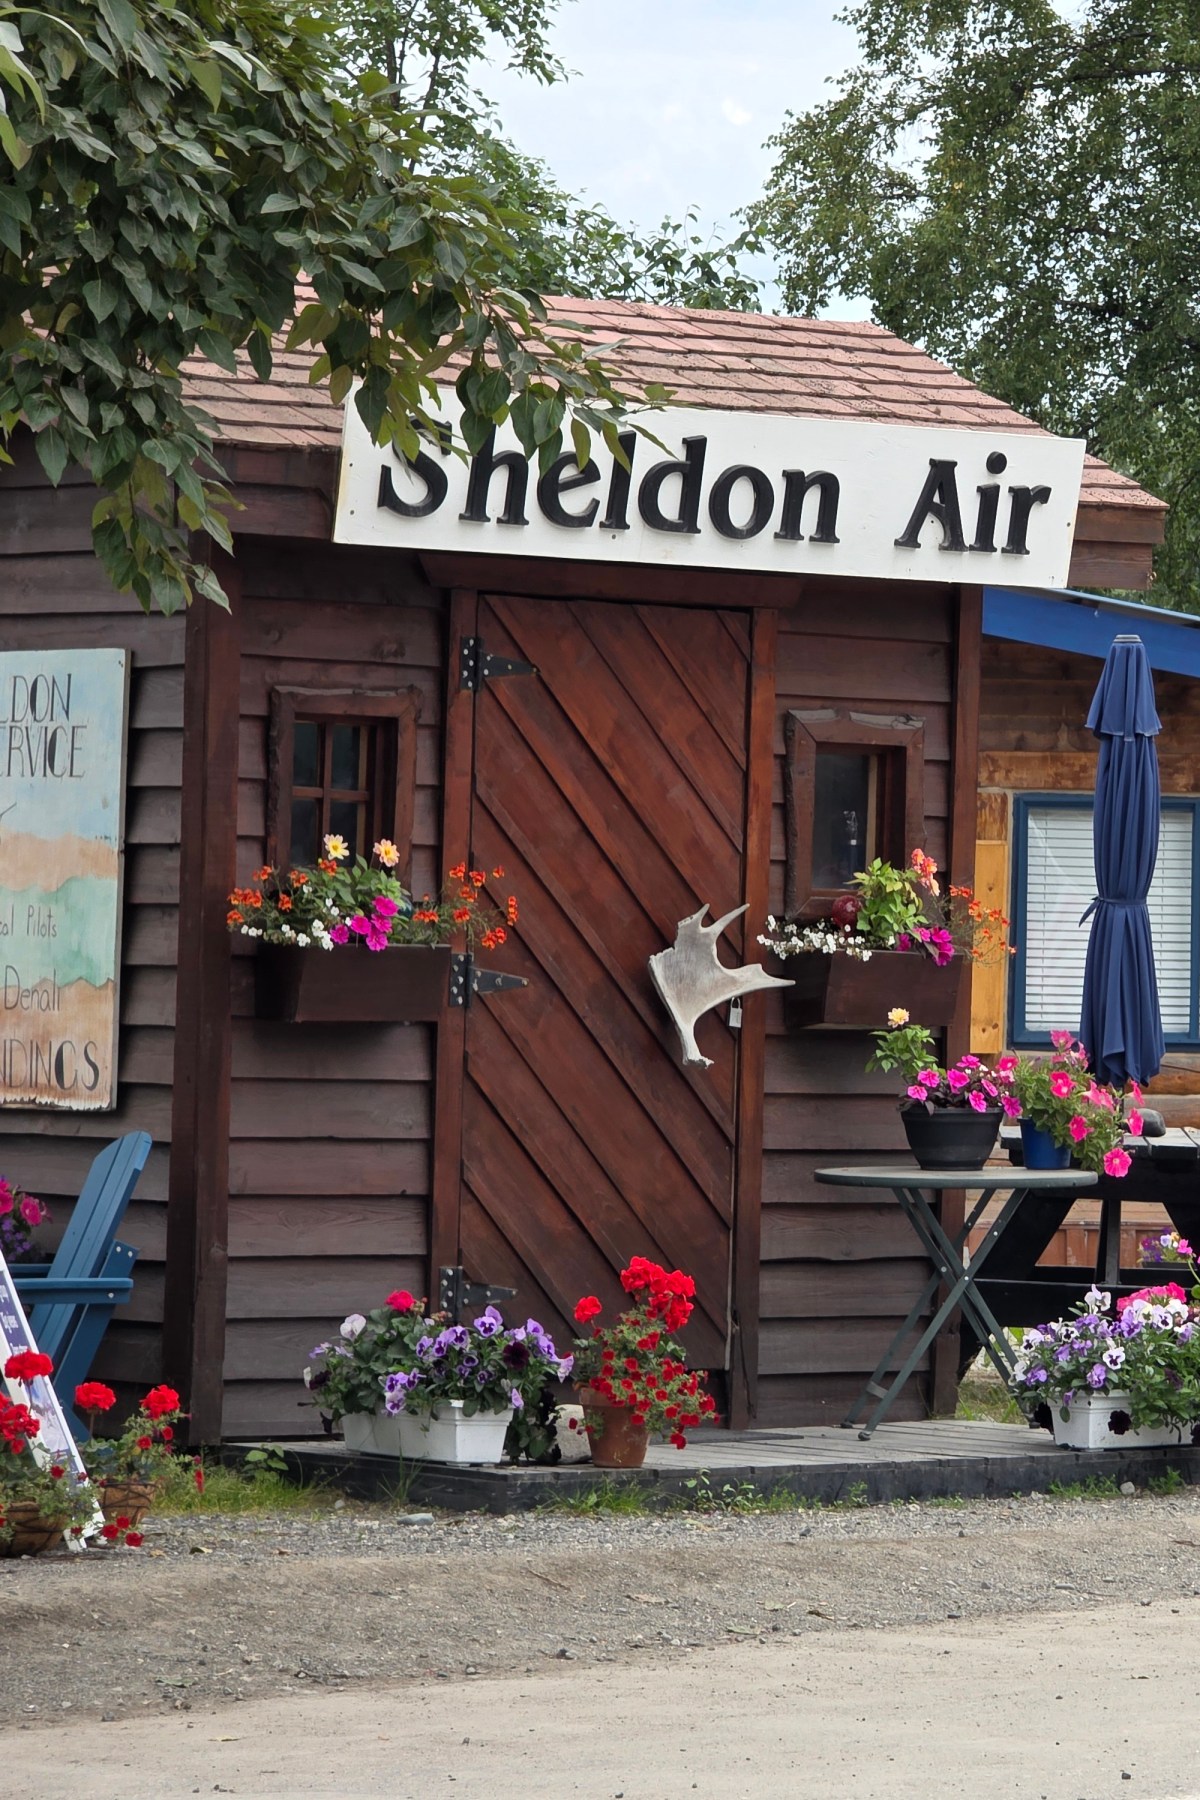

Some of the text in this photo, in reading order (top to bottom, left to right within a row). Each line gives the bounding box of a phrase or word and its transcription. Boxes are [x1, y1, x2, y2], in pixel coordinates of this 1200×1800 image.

[377, 415, 1052, 556] Sheldon Air
[0, 673, 72, 723] DON
[0, 725, 87, 778] RVICE
[26, 904, 57, 937] Pilots
[4, 965, 60, 1012] Denali
